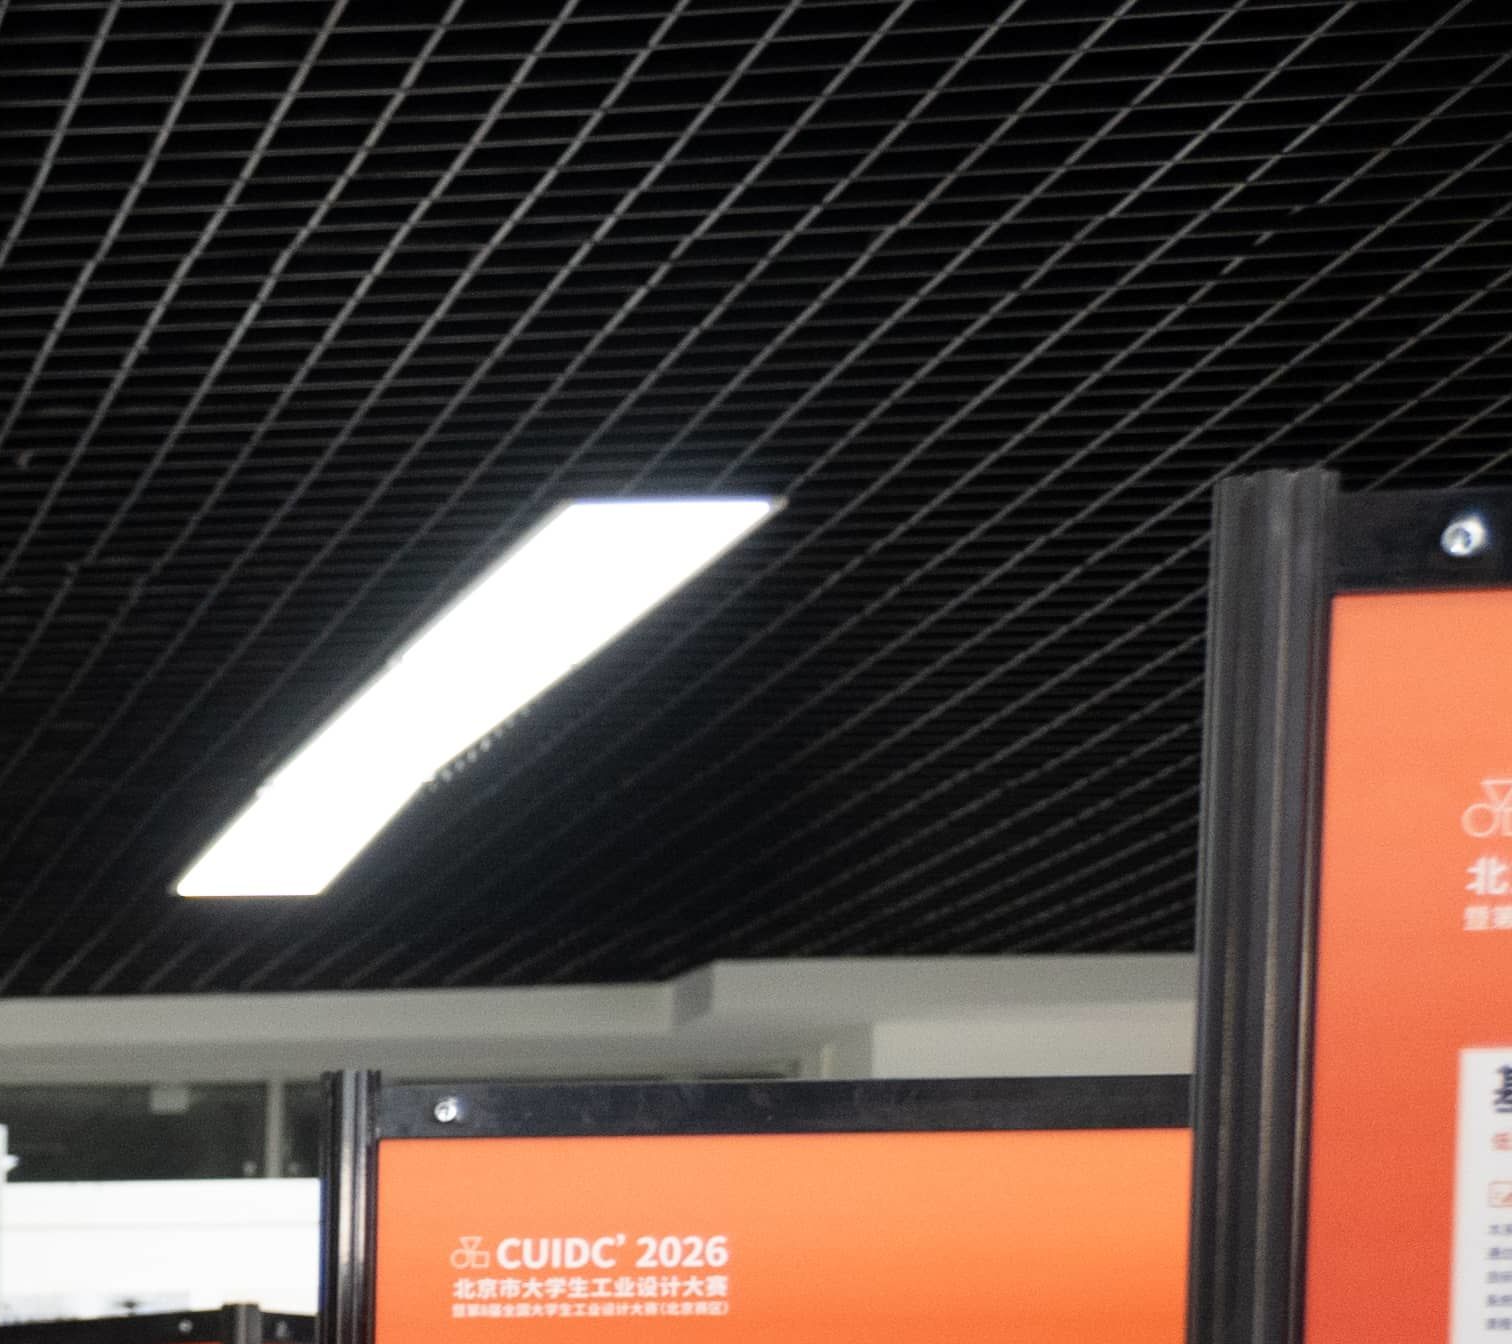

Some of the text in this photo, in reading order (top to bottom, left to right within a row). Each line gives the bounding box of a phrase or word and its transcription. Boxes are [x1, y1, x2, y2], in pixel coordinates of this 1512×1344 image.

[635, 1234, 730, 1269] 2026
[452, 1274, 729, 1300] 北京市大学生工业设计大赛
